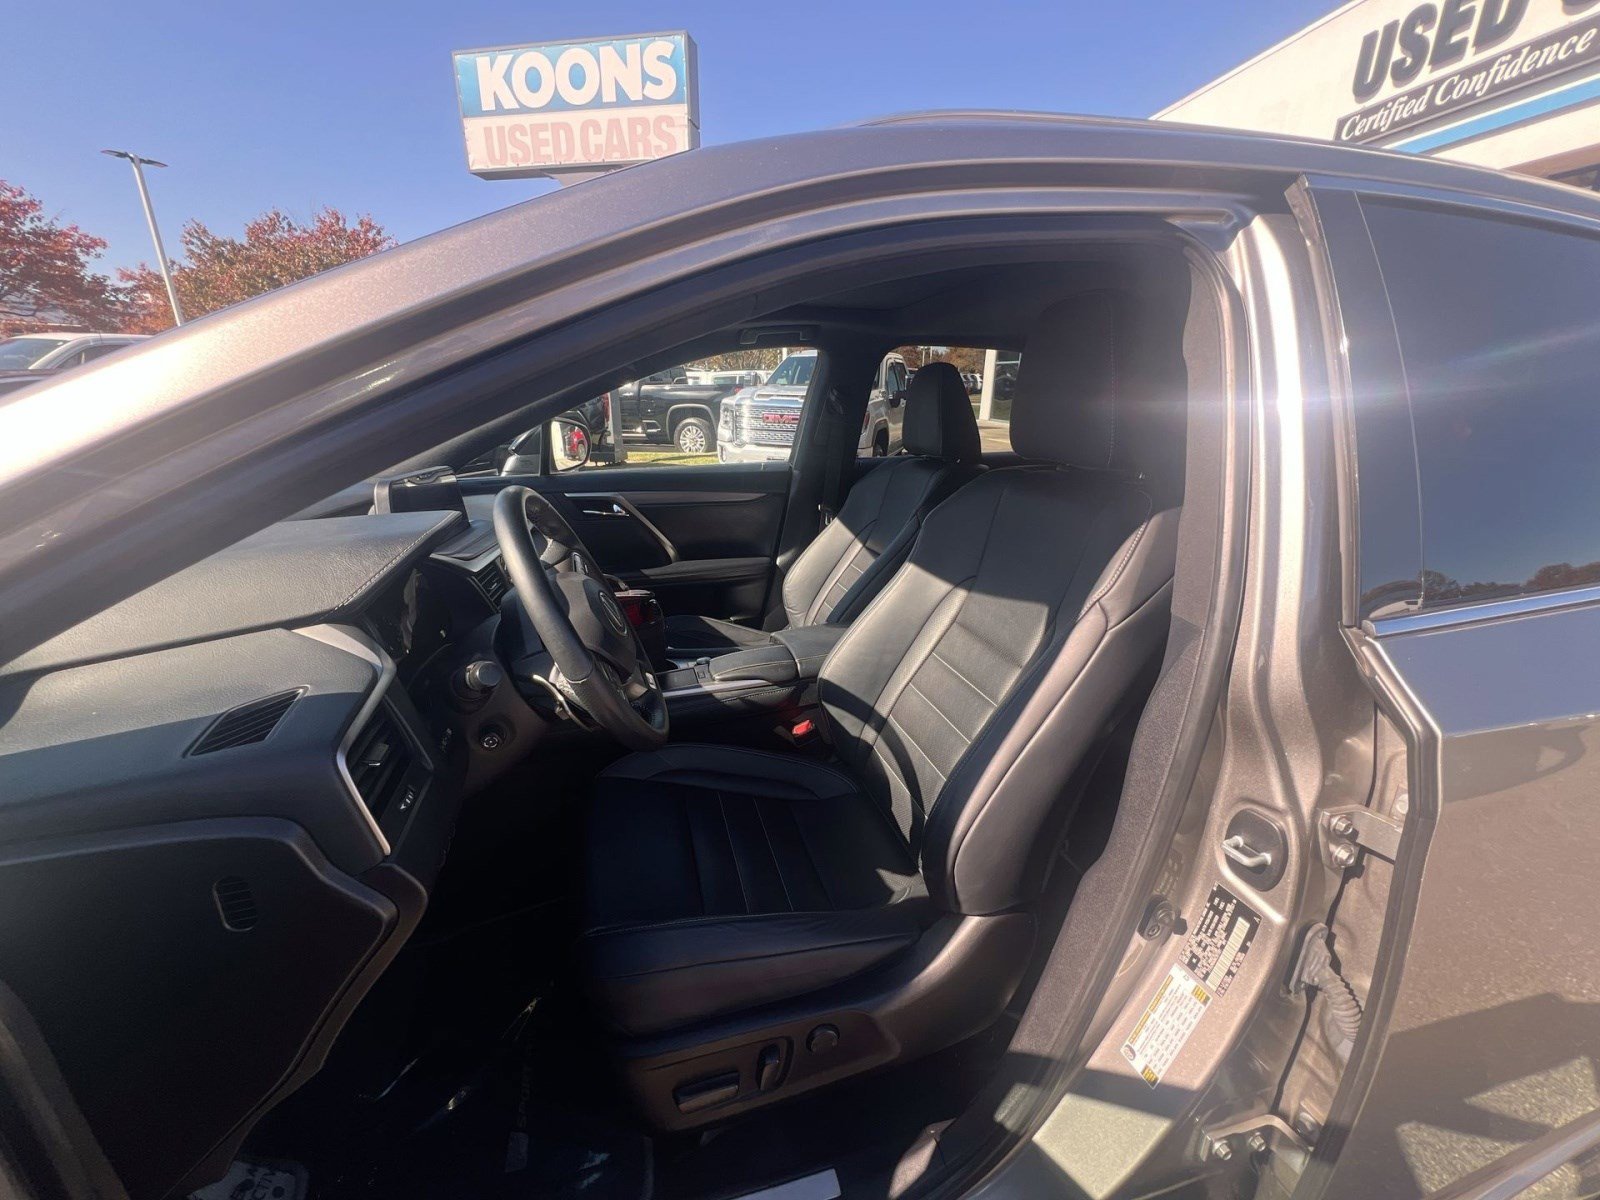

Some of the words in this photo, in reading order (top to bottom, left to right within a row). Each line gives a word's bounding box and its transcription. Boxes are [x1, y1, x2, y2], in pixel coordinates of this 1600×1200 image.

[475, 40, 678, 111] KOONS
[1341, 84, 1435, 140] Certified
[1434, 28, 1598, 105] Confidence
[1352, 0, 1530, 104] USED
[483, 121, 576, 166] USED
[579, 114, 678, 161] CARS
[763, 413, 800, 424] GMC
